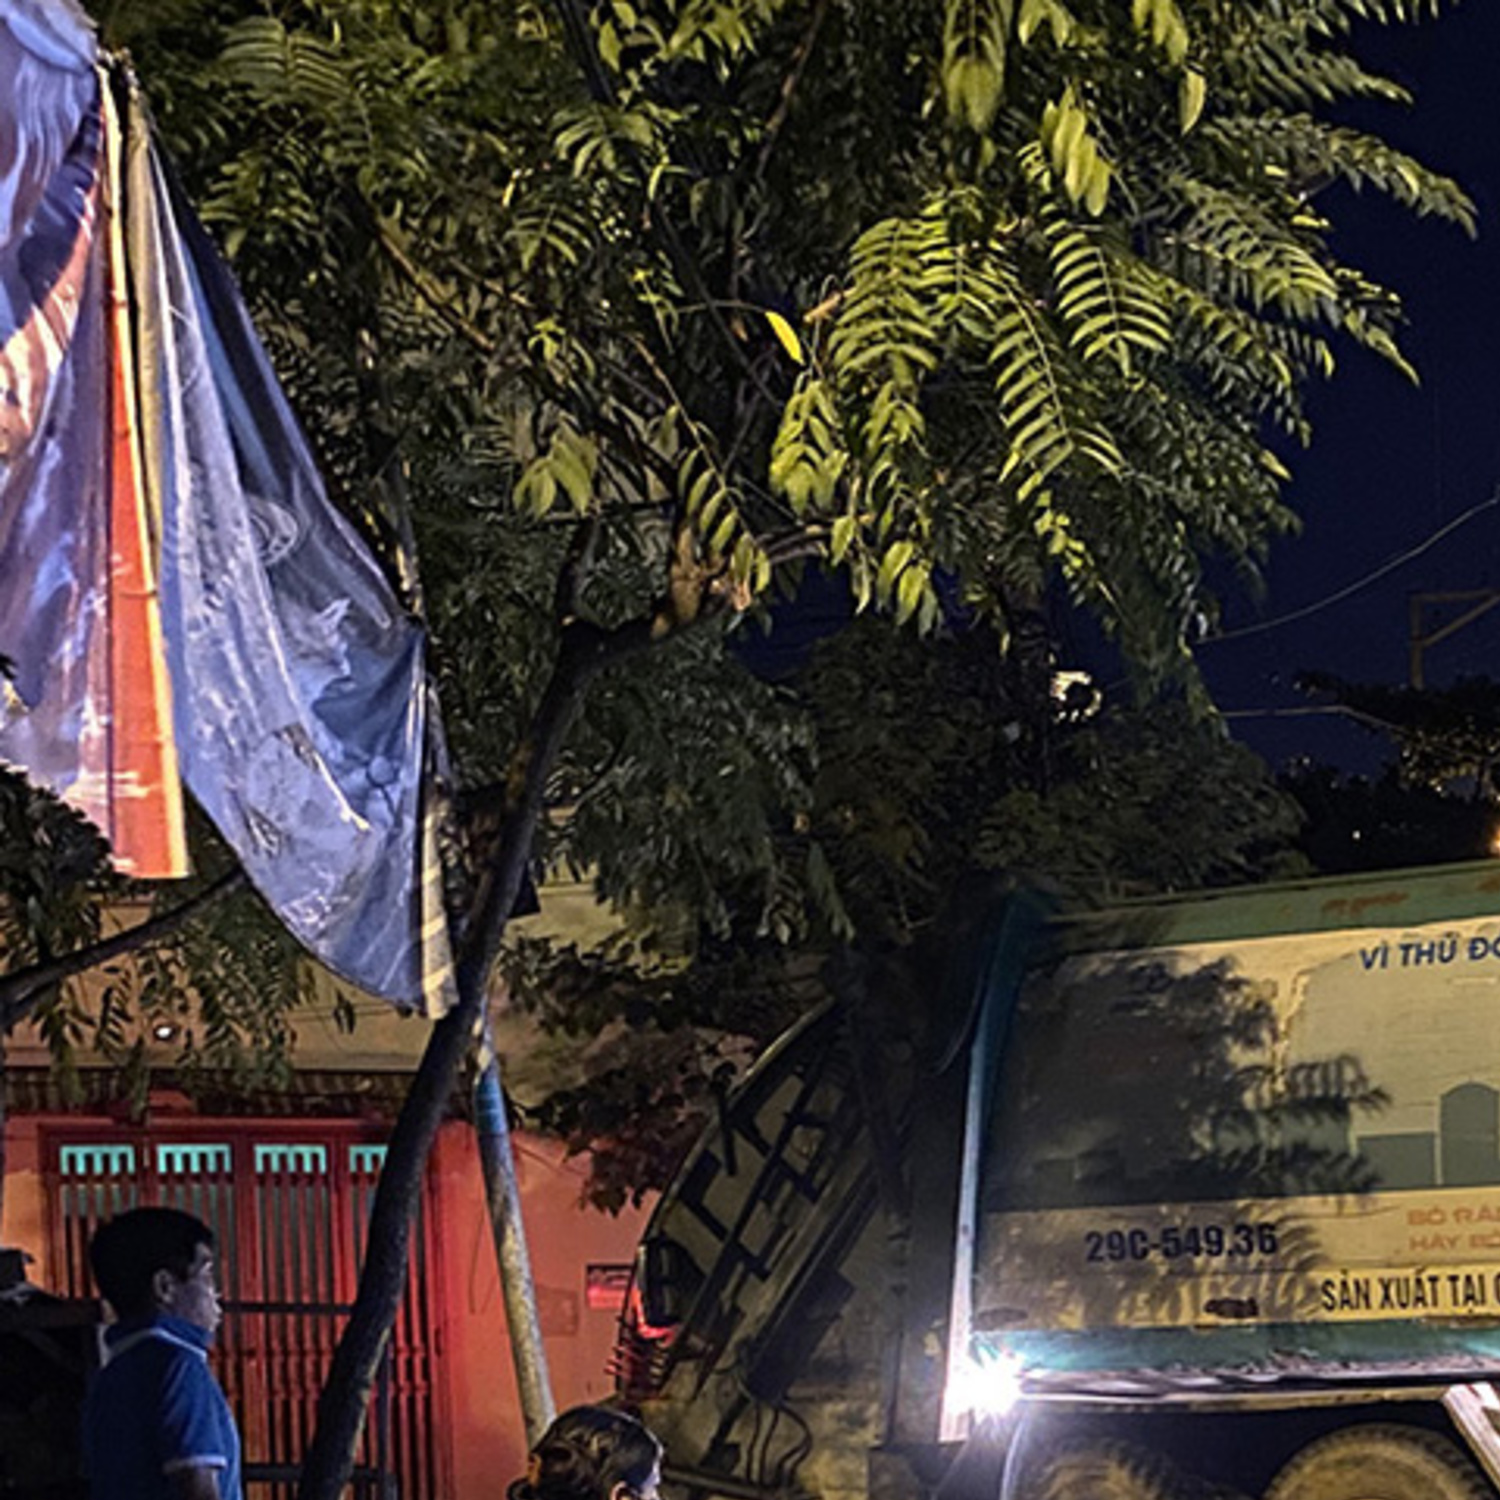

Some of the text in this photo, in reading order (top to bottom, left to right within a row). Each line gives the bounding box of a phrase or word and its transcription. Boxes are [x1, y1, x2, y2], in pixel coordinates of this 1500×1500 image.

[1084, 1222, 1279, 1262] 29C-549.36
[1320, 1268, 1371, 1312] SẢN
[1378, 1265, 1440, 1310] XUẤT
[1447, 1273, 1486, 1313] TẠI
